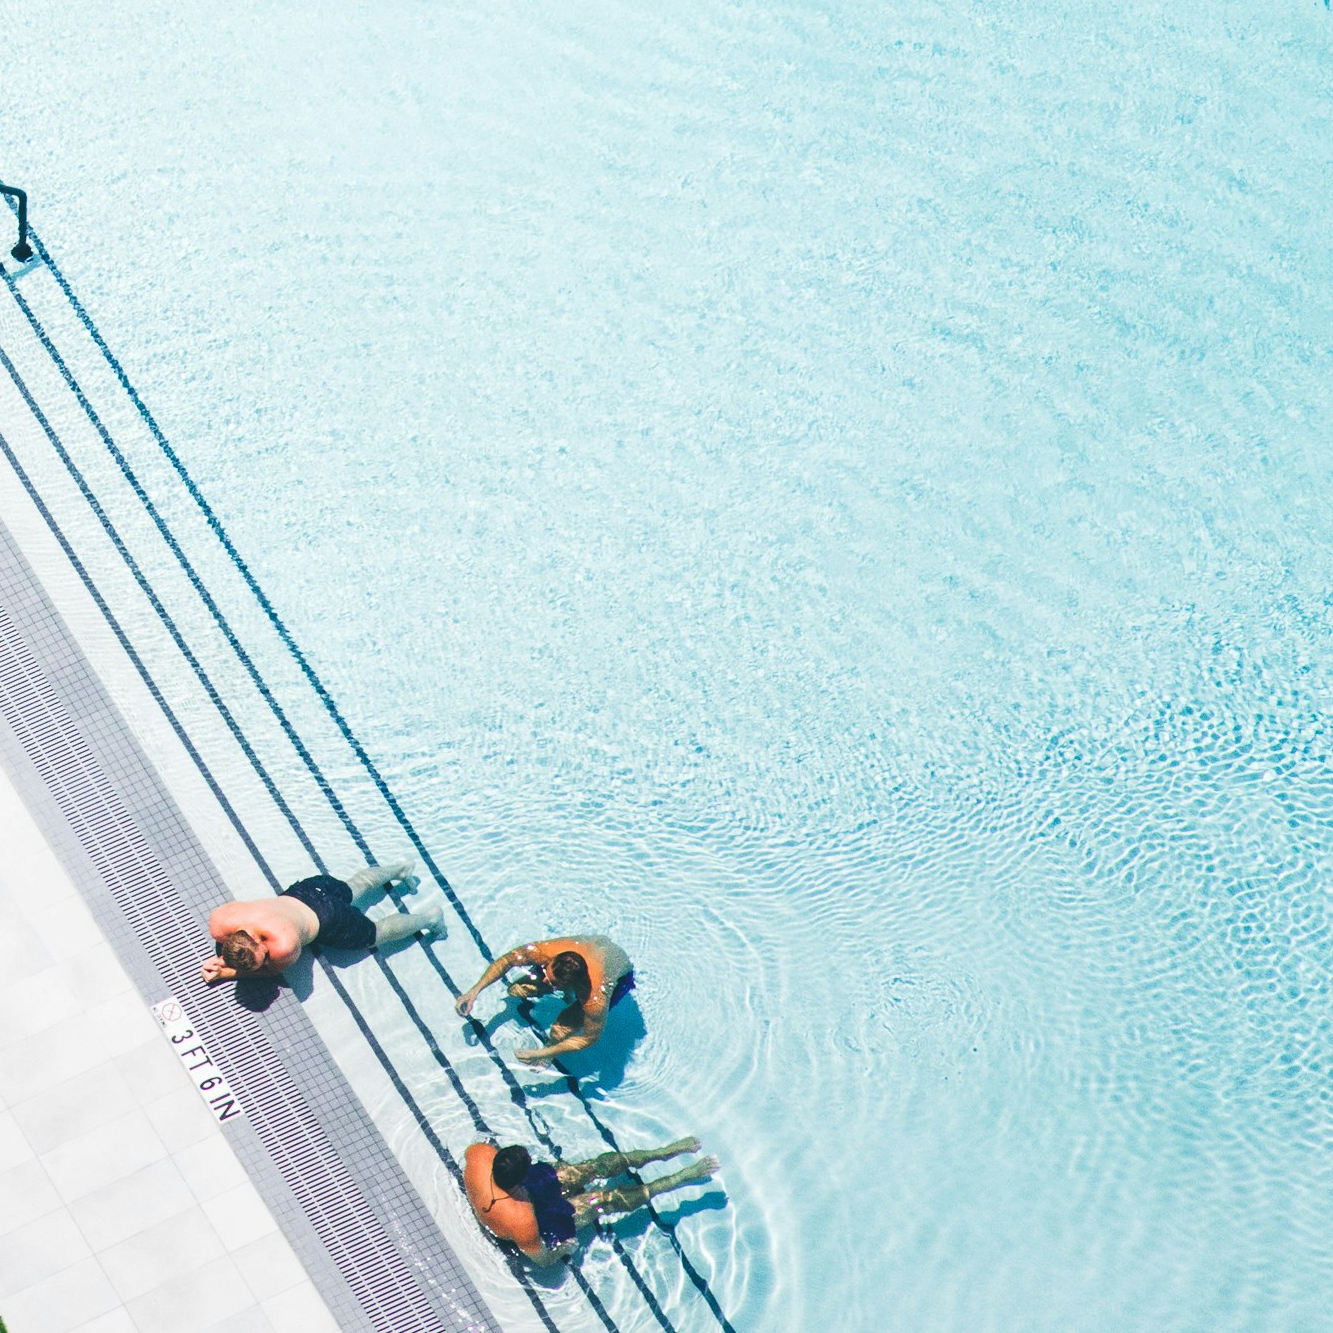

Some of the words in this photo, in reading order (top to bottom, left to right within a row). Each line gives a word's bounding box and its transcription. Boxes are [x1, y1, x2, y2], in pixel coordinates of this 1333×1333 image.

[171, 1029, 194, 1045] 3
[180, 1045, 214, 1071] FT
[199, 1076, 223, 1091] 6
[209, 1093, 241, 1122] IN
